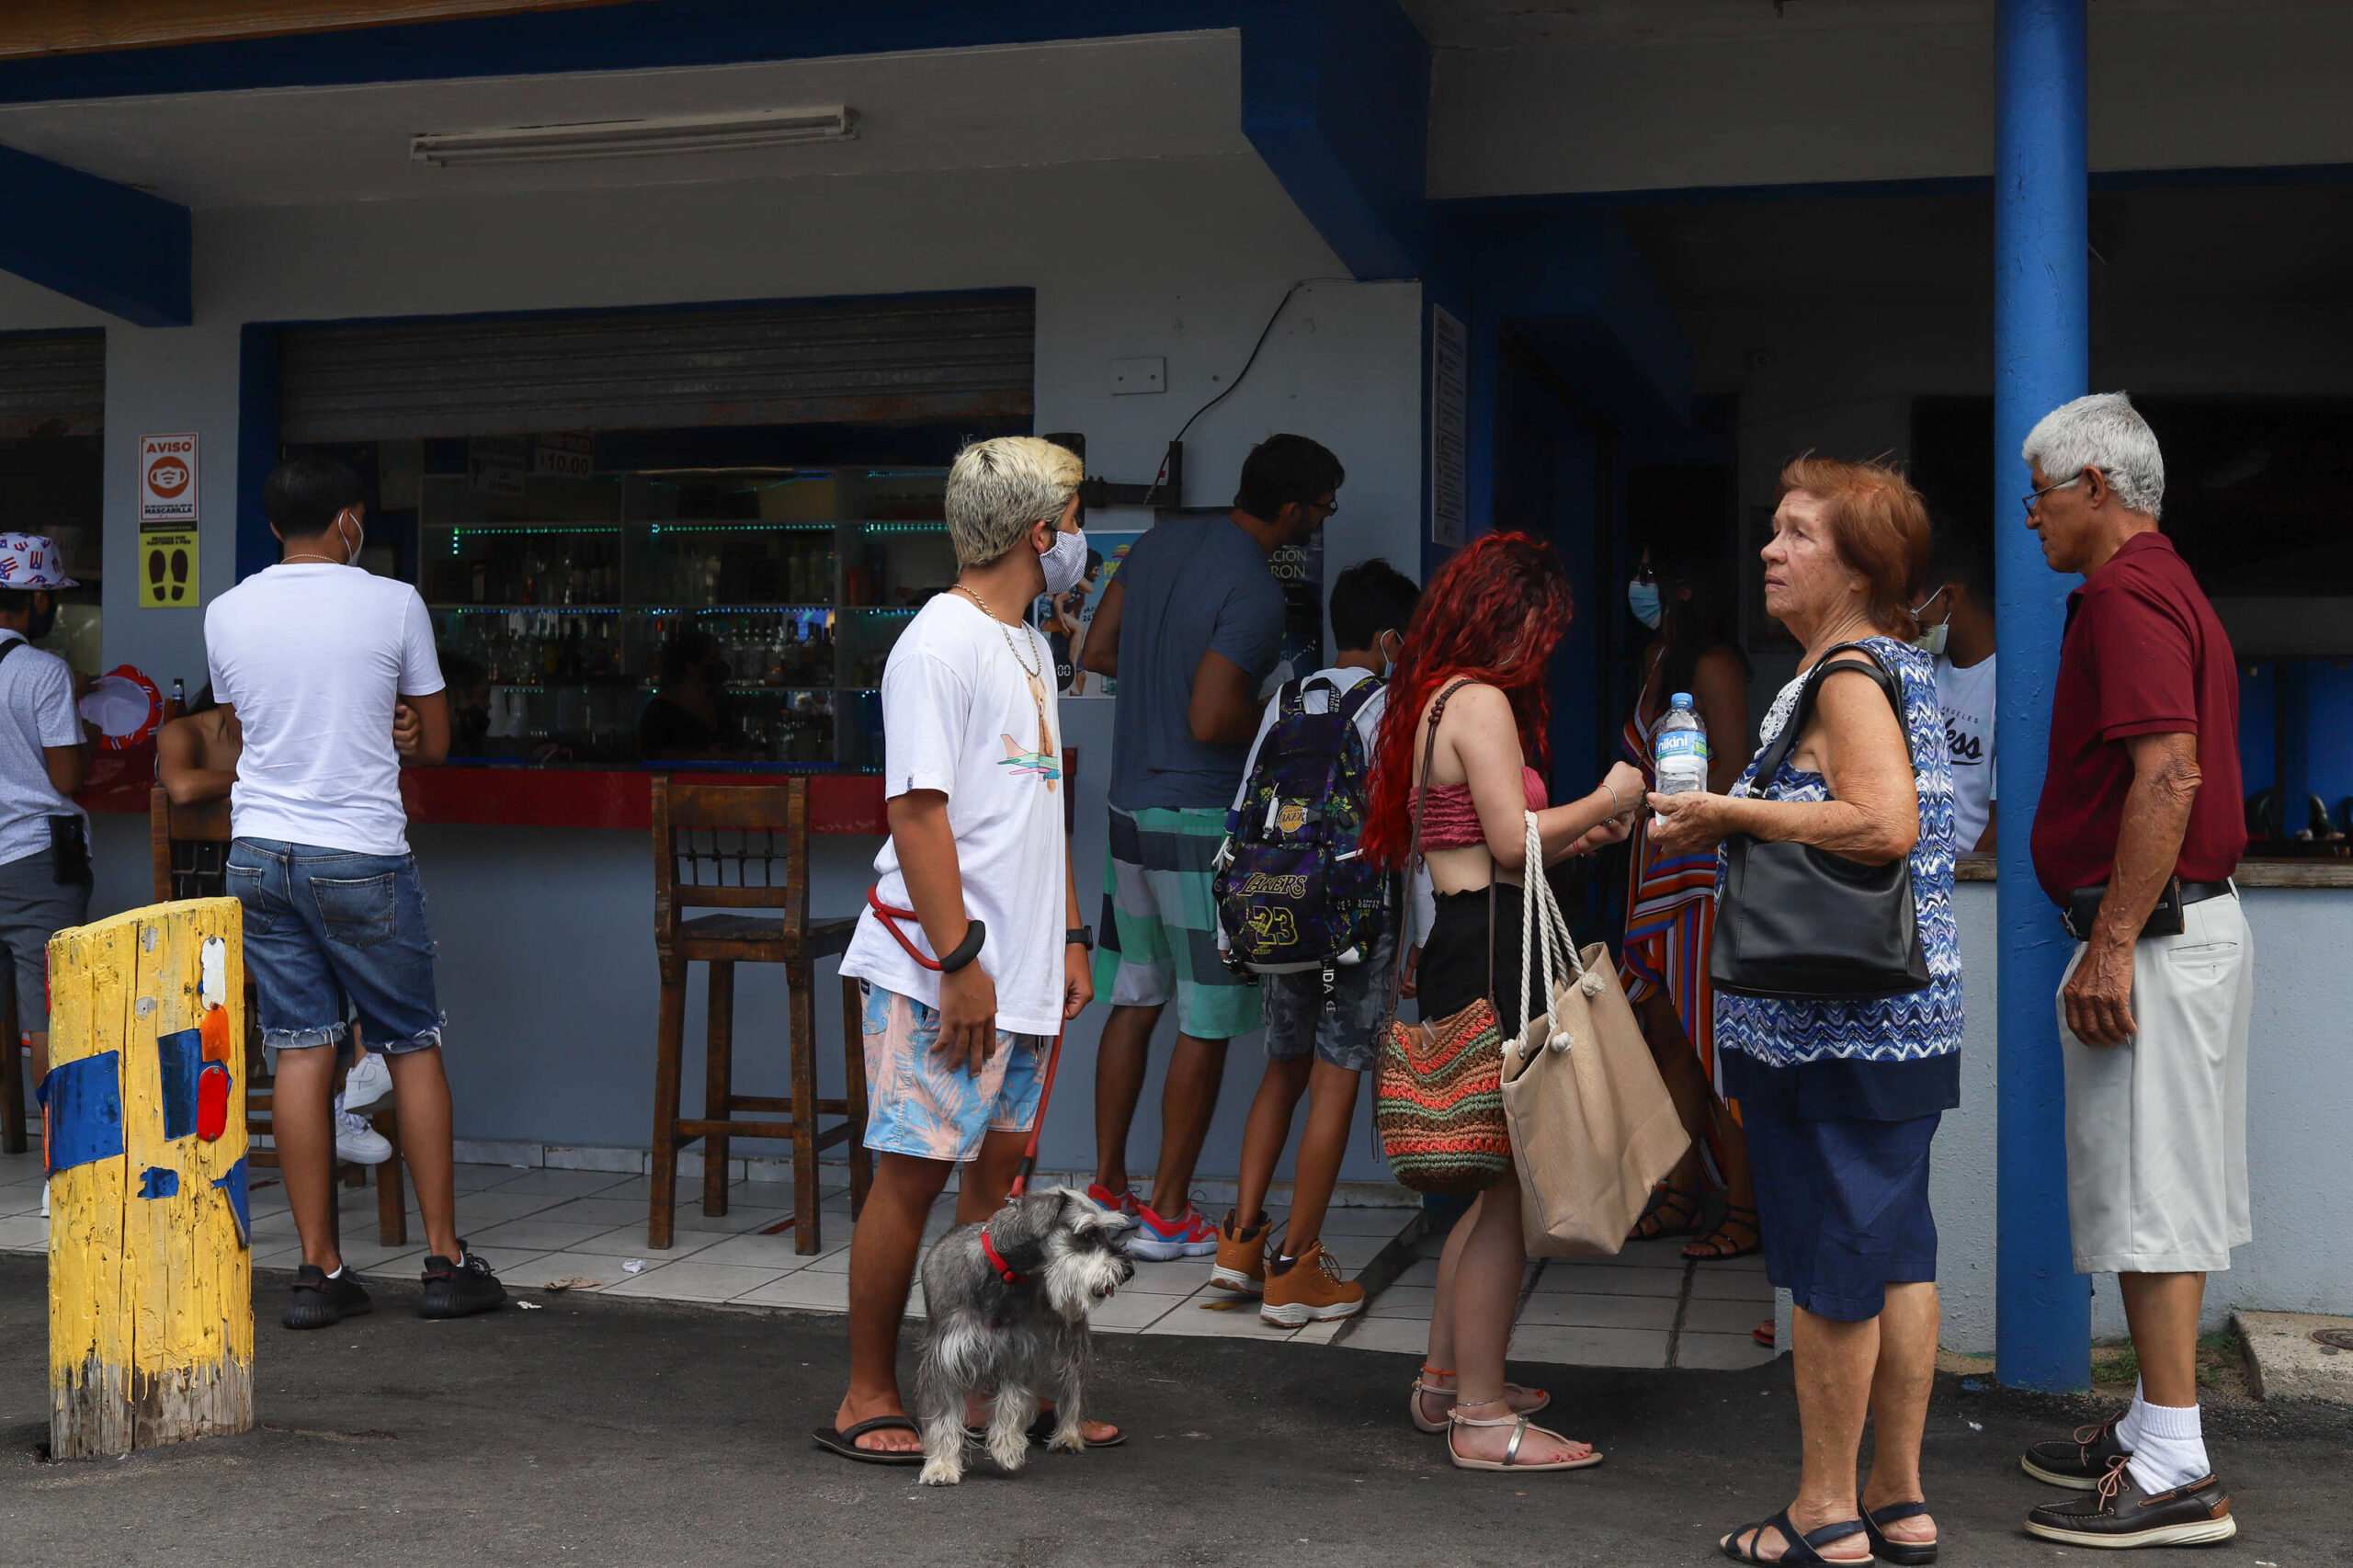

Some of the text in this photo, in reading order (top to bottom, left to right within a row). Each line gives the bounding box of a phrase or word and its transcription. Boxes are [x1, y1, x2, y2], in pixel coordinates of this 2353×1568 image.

[146, 441, 192, 453] AVISO
[1268, 547, 1307, 562] CIÓN
[1940, 706, 1979, 724] ANGELES
[1658, 734, 1688, 753] nikini
[1235, 871, 1309, 900] LAKERS
[1252, 905, 1300, 946] 23
